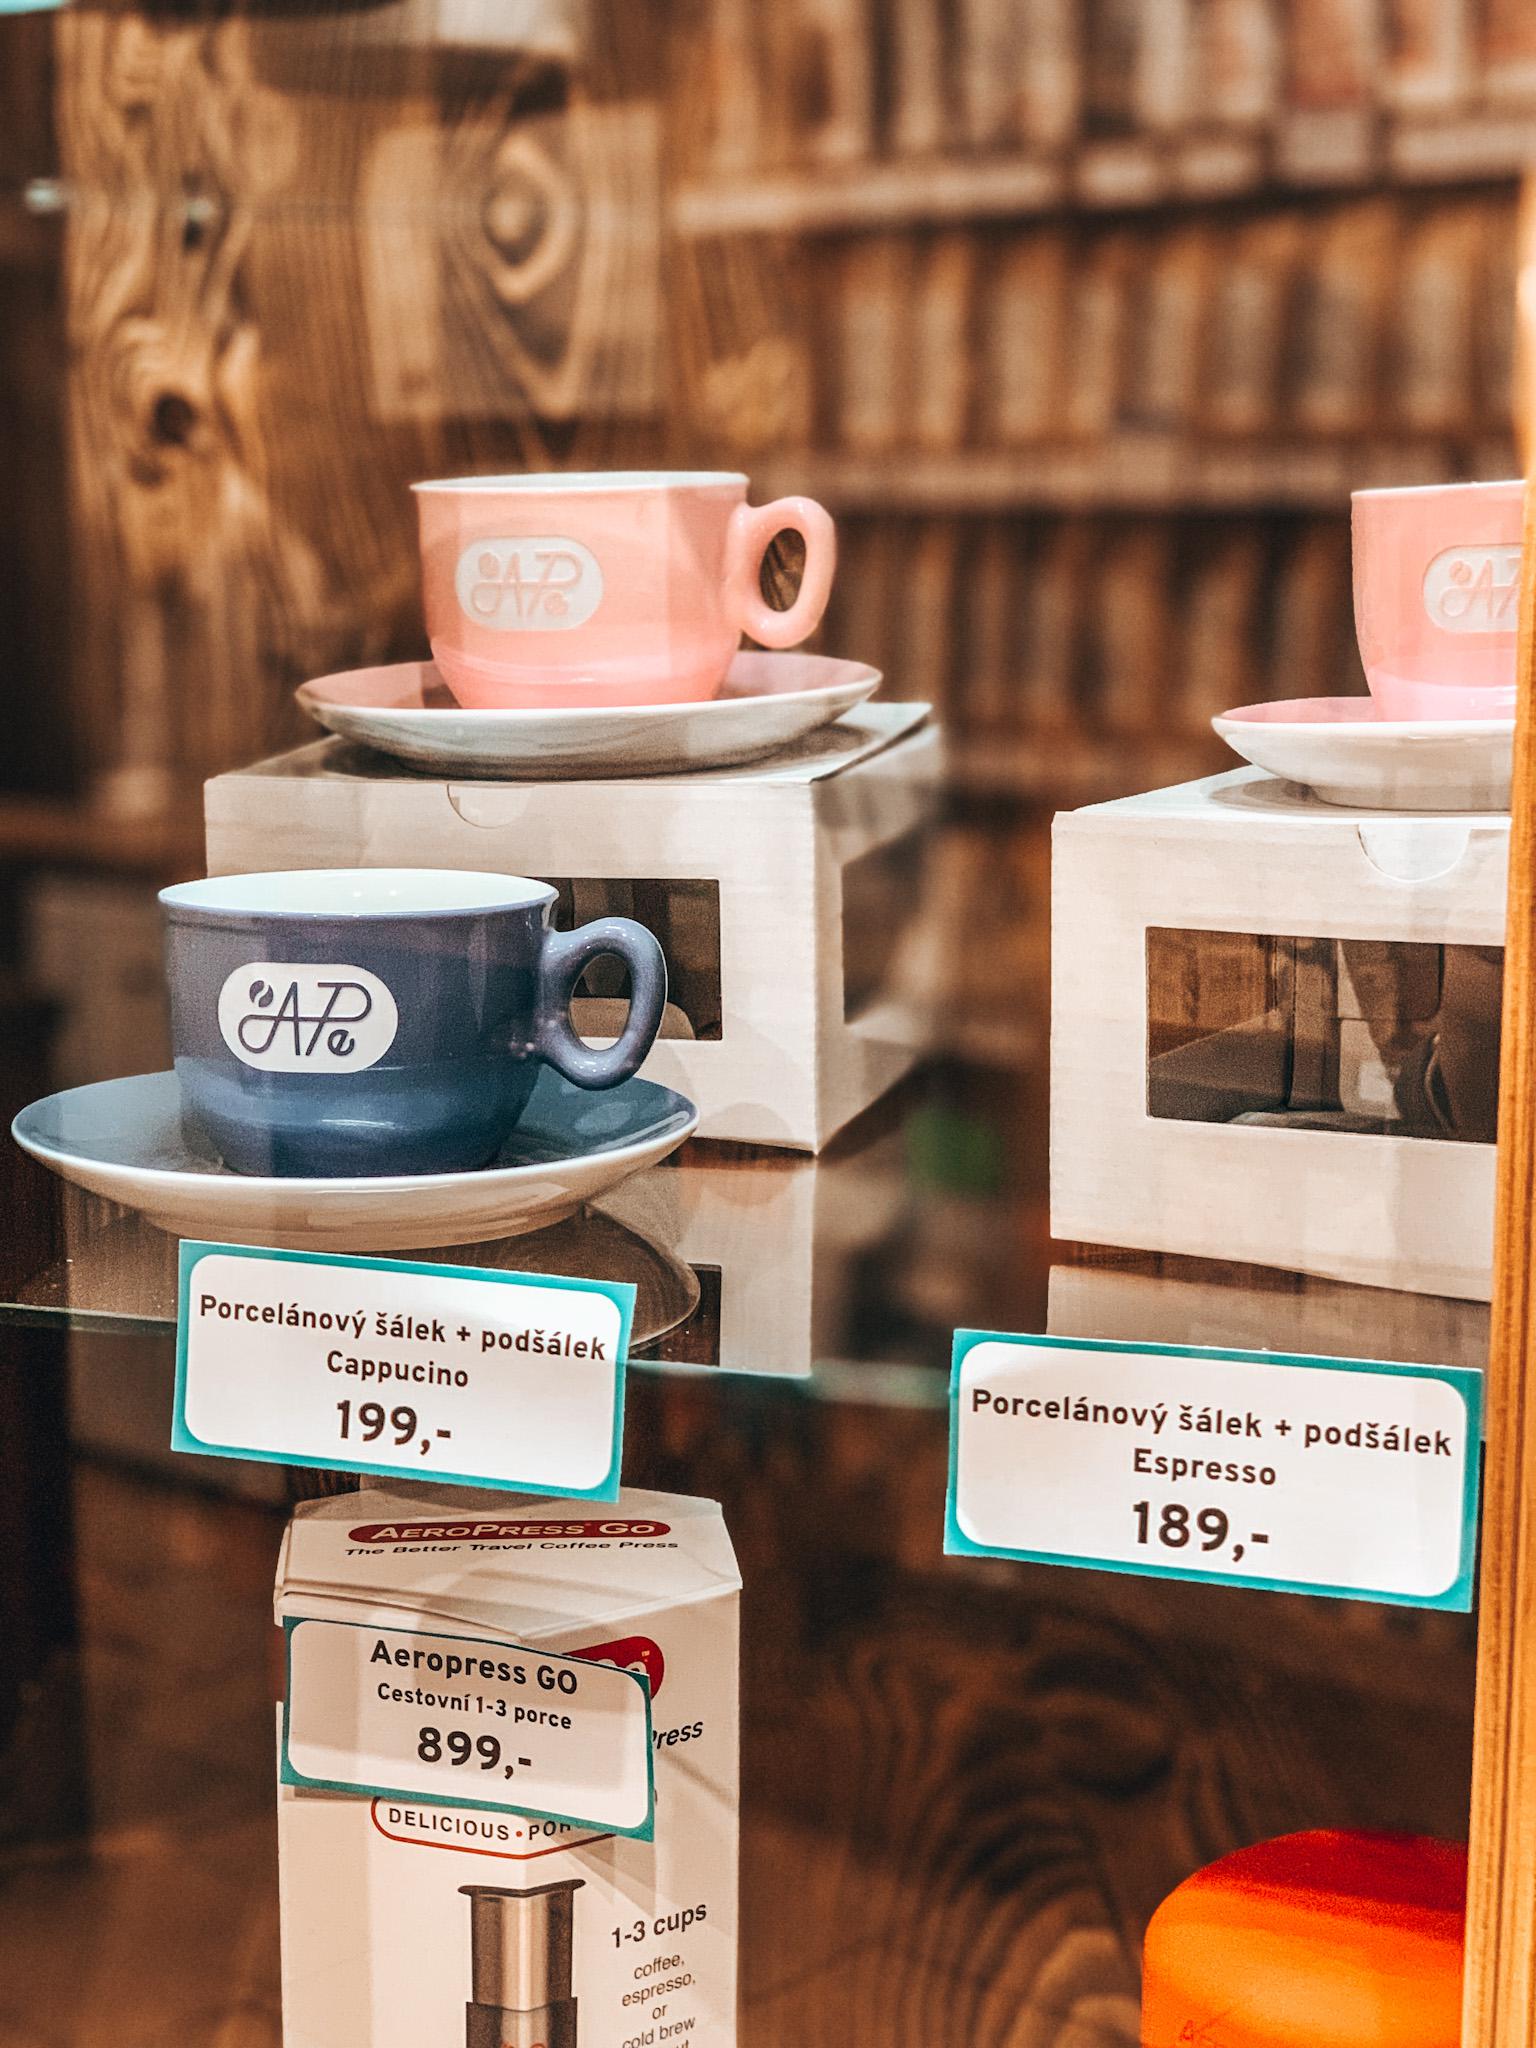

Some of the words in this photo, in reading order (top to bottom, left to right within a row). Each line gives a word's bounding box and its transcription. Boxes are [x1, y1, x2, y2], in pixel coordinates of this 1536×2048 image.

[200, 1294, 366, 1339] Porcelánový
[376, 1311, 446, 1343] šálek
[457, 1326, 471, 1342] +
[482, 1327, 606, 1361] podšálek
[327, 1350, 469, 1387] Cappucino
[337, 1399, 451, 1456] 199,-
[972, 1388, 1168, 1435] Porcelánový
[1178, 1404, 1263, 1438] šálek
[1275, 1419, 1292, 1437] +
[1304, 1422, 1452, 1457] podšálek
[1133, 1448, 1276, 1486] Espresso
[393, 1545, 462, 1554] Better
[470, 1543, 533, 1551] Travel
[540, 1542, 611, 1550] Coffee
[619, 1541, 678, 1549] Press
[1132, 1500, 1270, 1563] 189,-
[370, 1640, 527, 1686] Aeropress
[537, 1666, 578, 1695] GO
[377, 1683, 471, 1711] Cestovní
[476, 1695, 506, 1717] 1-3
[514, 1707, 572, 1730] porce
[417, 1727, 532, 1780] 899,-
[389, 1808, 509, 1840] DELICIOUS
[611, 1920, 645, 1948] 1-3
[653, 1903, 707, 1936] cups
[622, 2028, 654, 2048] cold
[660, 2017, 696, 2040] brew
[652, 2004, 667, 2019] or
